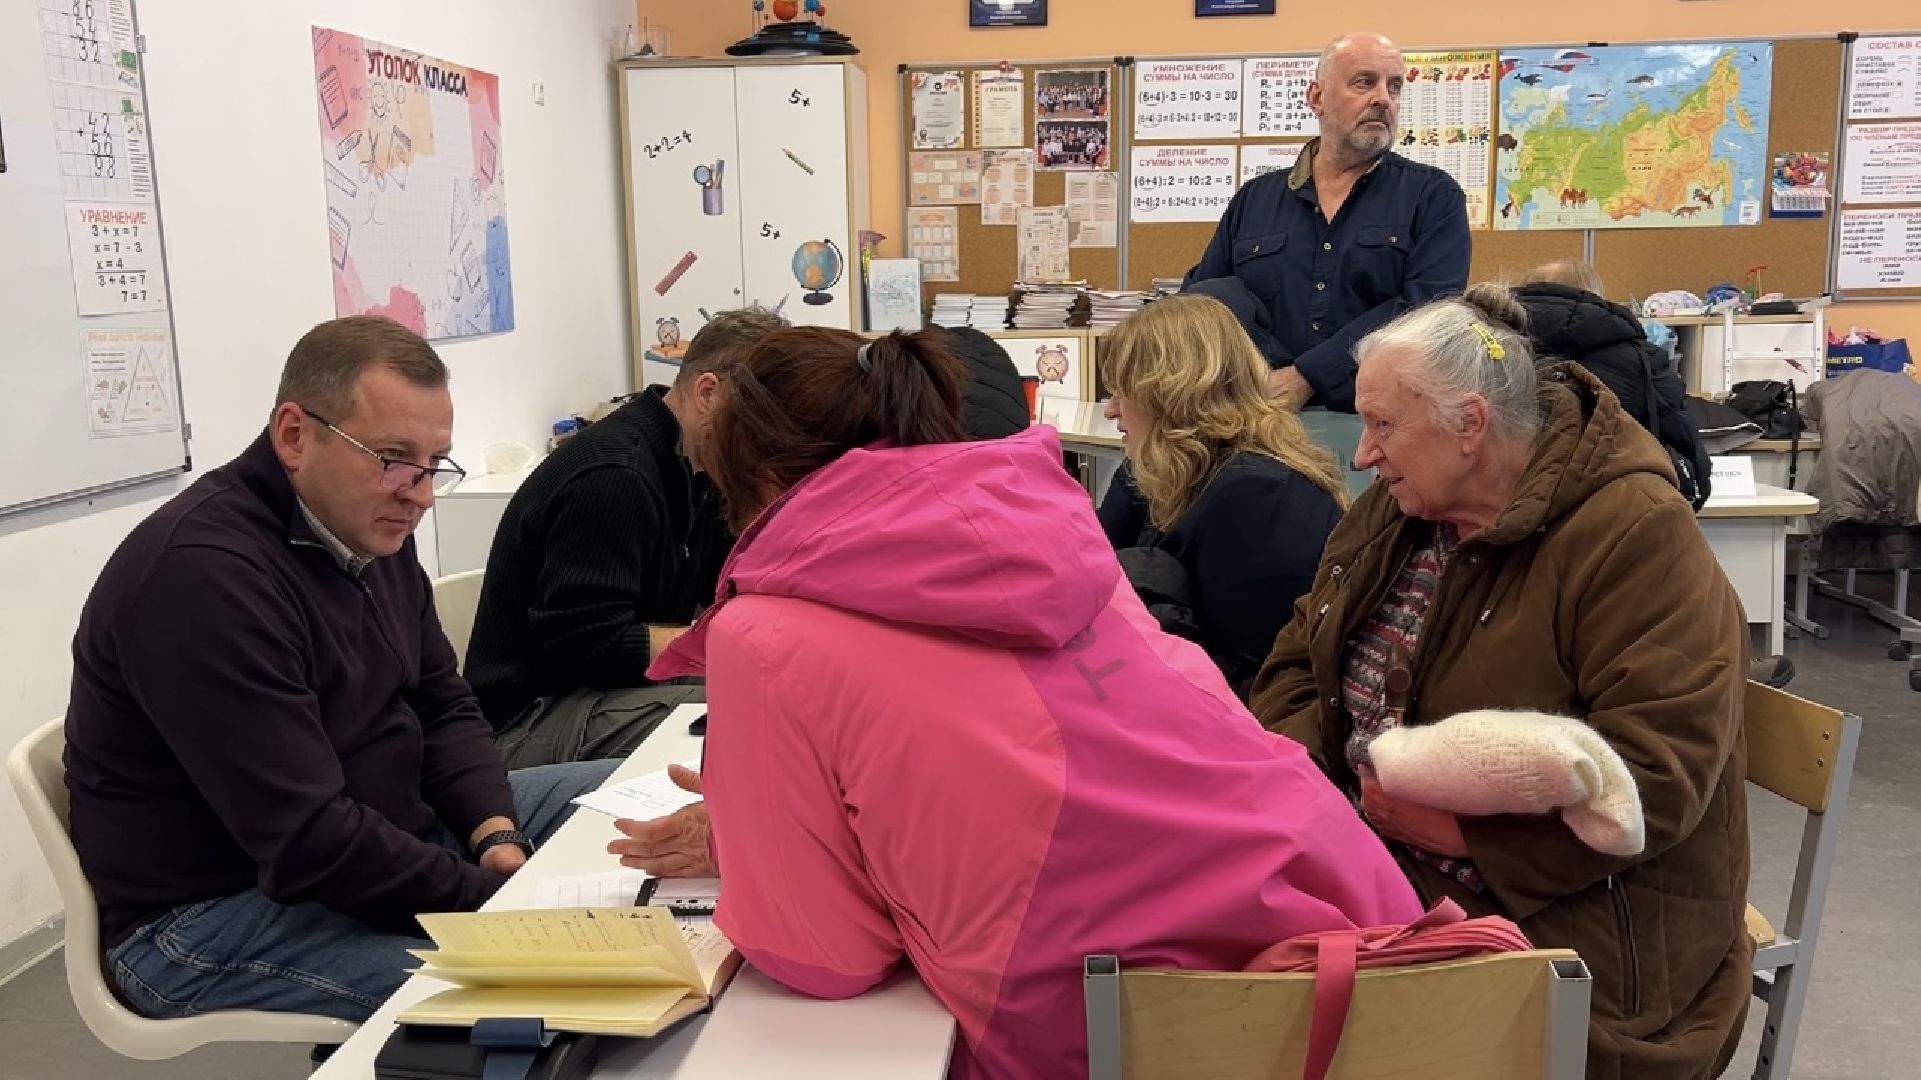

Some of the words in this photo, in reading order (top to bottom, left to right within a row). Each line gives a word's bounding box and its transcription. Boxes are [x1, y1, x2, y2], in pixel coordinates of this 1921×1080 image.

[1868, 41, 1912, 49] СОСТАВ
[1153, 63, 1226, 73] УМНОЖЕНИЕ
[1256, 61, 1314, 69] ПЕРИМЕТР
[366, 48, 421, 85] УГОЛОК
[423, 63, 468, 98] КЛАССА
[1143, 73, 1181, 82] СУММЫ
[1183, 73, 1197, 81] НА
[1200, 72, 1234, 80] ЧИСЛО
[1225, 90, 1238, 101] 30
[1157, 149, 1208, 157] ДЕЛЕНИЕ
[1139, 158, 1175, 167] СУММЫ
[1178, 158, 1192, 166] НА
[1195, 157, 1230, 166] ЧИСЛО
[1226, 175, 1232, 185] 5
[80, 209, 147, 225] УРАВНЕНИЕ
